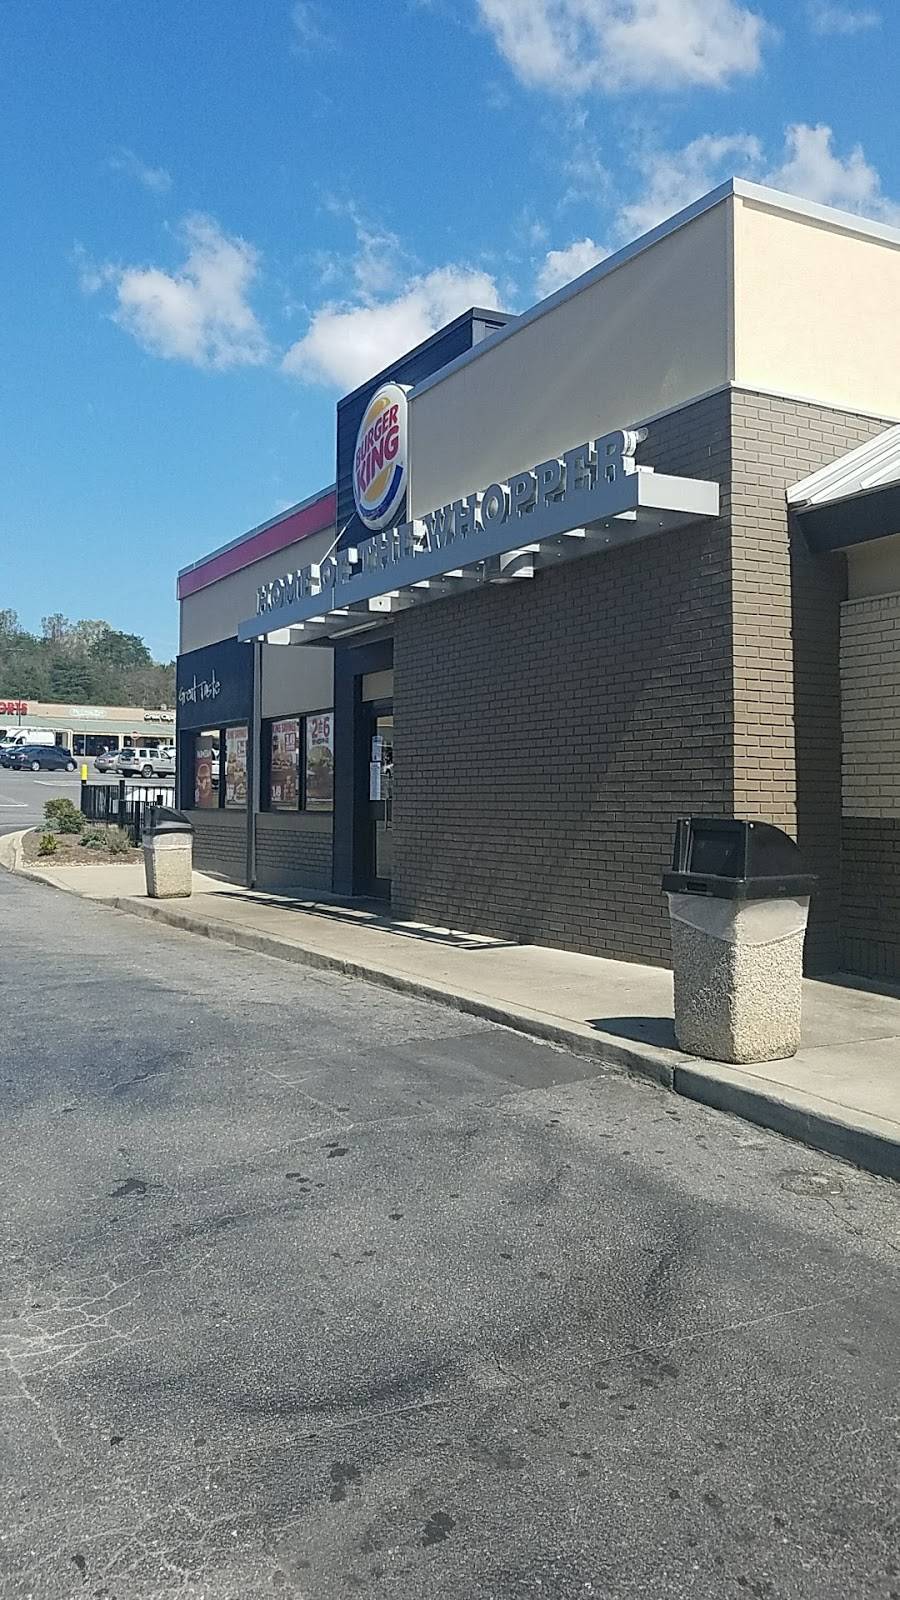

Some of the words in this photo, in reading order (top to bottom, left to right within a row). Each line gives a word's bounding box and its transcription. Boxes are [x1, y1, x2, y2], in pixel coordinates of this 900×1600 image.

[355, 403, 399, 470] BURGER
[357, 424, 400, 502] KING
[256, 563, 320, 616] HOME
[320, 548, 357, 590] OF
[357, 518, 424, 573] THE
[423, 430, 636, 553] WHOPPER
[178, 674, 196, 706] Great
[197, 669, 220, 700] Taste
